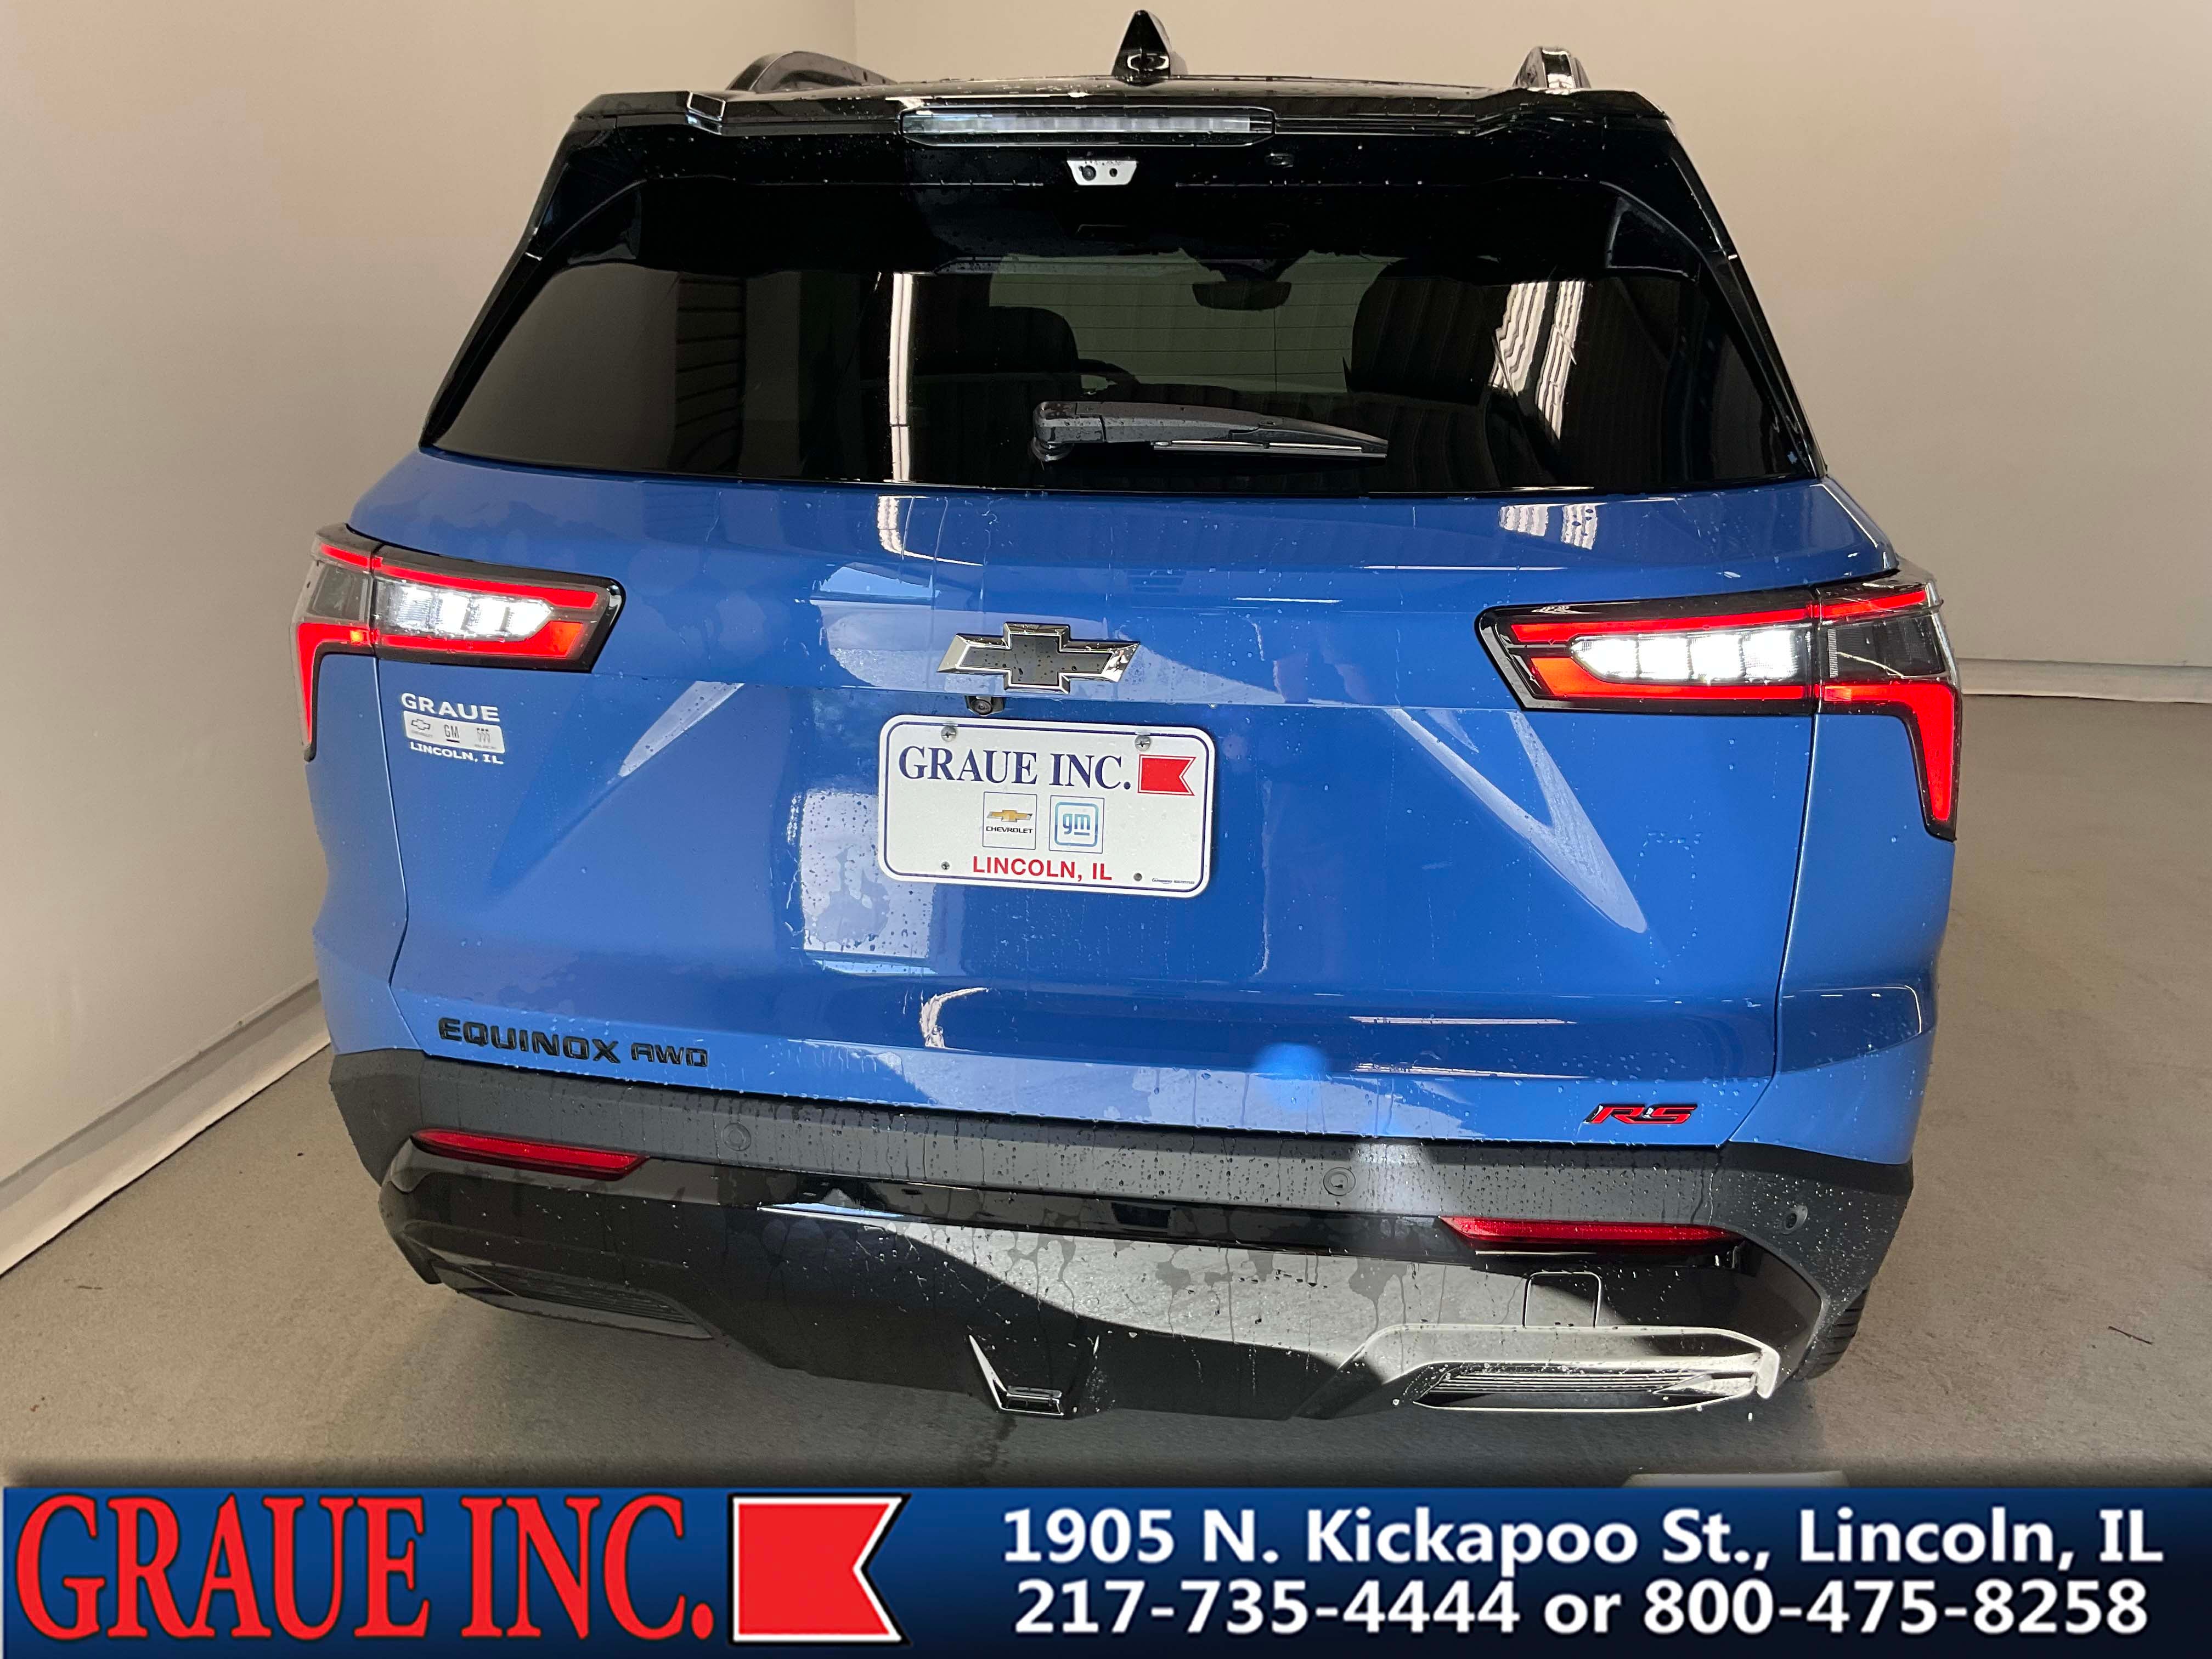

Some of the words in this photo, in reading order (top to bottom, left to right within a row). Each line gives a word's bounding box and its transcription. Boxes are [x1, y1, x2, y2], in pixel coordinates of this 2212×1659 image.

[401, 692, 500, 722] GRAUE
[444, 724, 459, 739] GM
[410, 741, 478, 763] LINCOLN,
[482, 753, 504, 765] IL
[898, 745, 1038, 786] GRAUE
[1048, 753, 1132, 790] INC.
[986, 826, 1034, 834] CHEVROLET
[1062, 813, 1091, 835] gm
[973, 856, 1082, 882] LINCOLN,
[1092, 863, 1113, 881] IL
[438, 1017, 621, 1064] EQUINOX
[630, 1042, 709, 1068] AWD
[1583, 1103, 1697, 1124] RS
